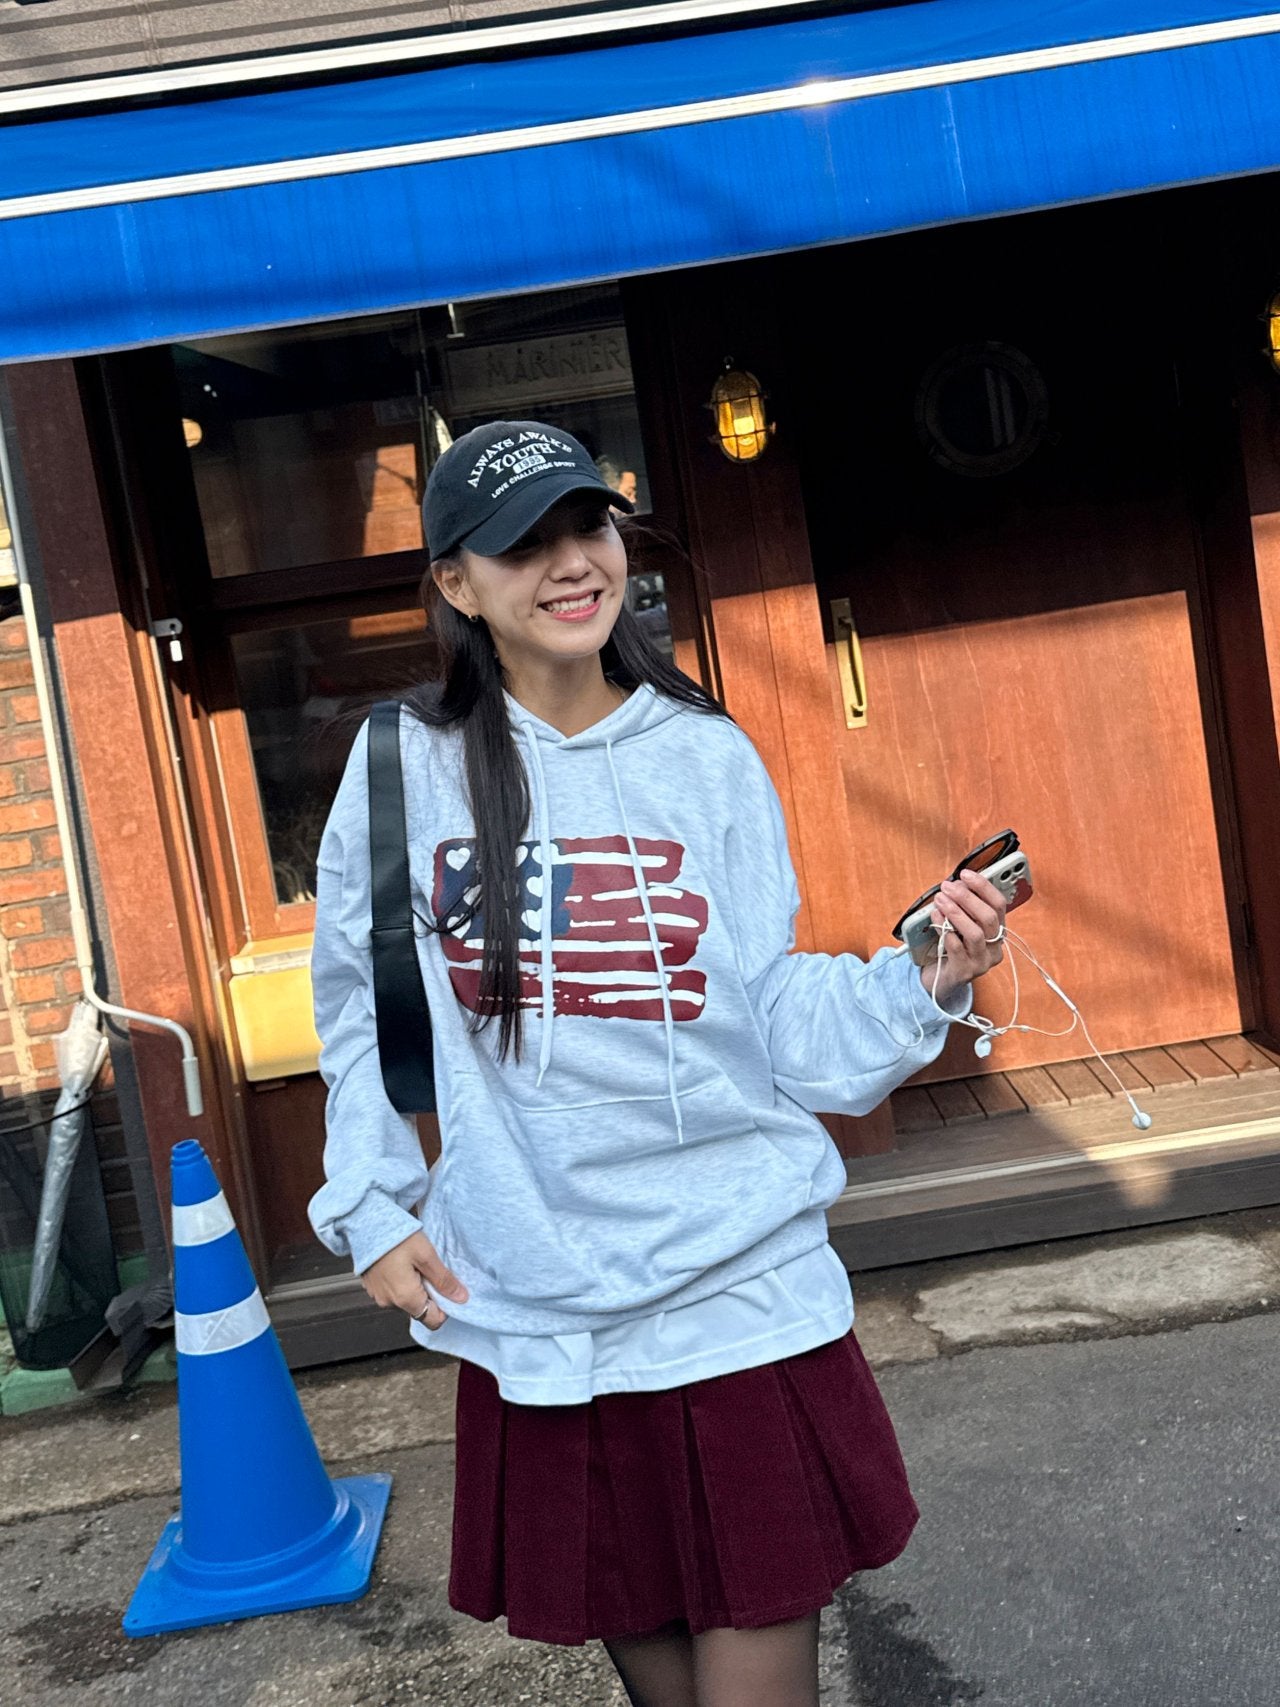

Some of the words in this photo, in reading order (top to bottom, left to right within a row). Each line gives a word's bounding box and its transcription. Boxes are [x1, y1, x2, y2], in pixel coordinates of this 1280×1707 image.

[467, 437, 515, 488] ALWAYS
[518, 431, 573, 453] AWAKE
[489, 442, 556, 474] YOUTH
[491, 481, 510, 499] LOVE
[509, 461, 554, 484] CHALLENGE
